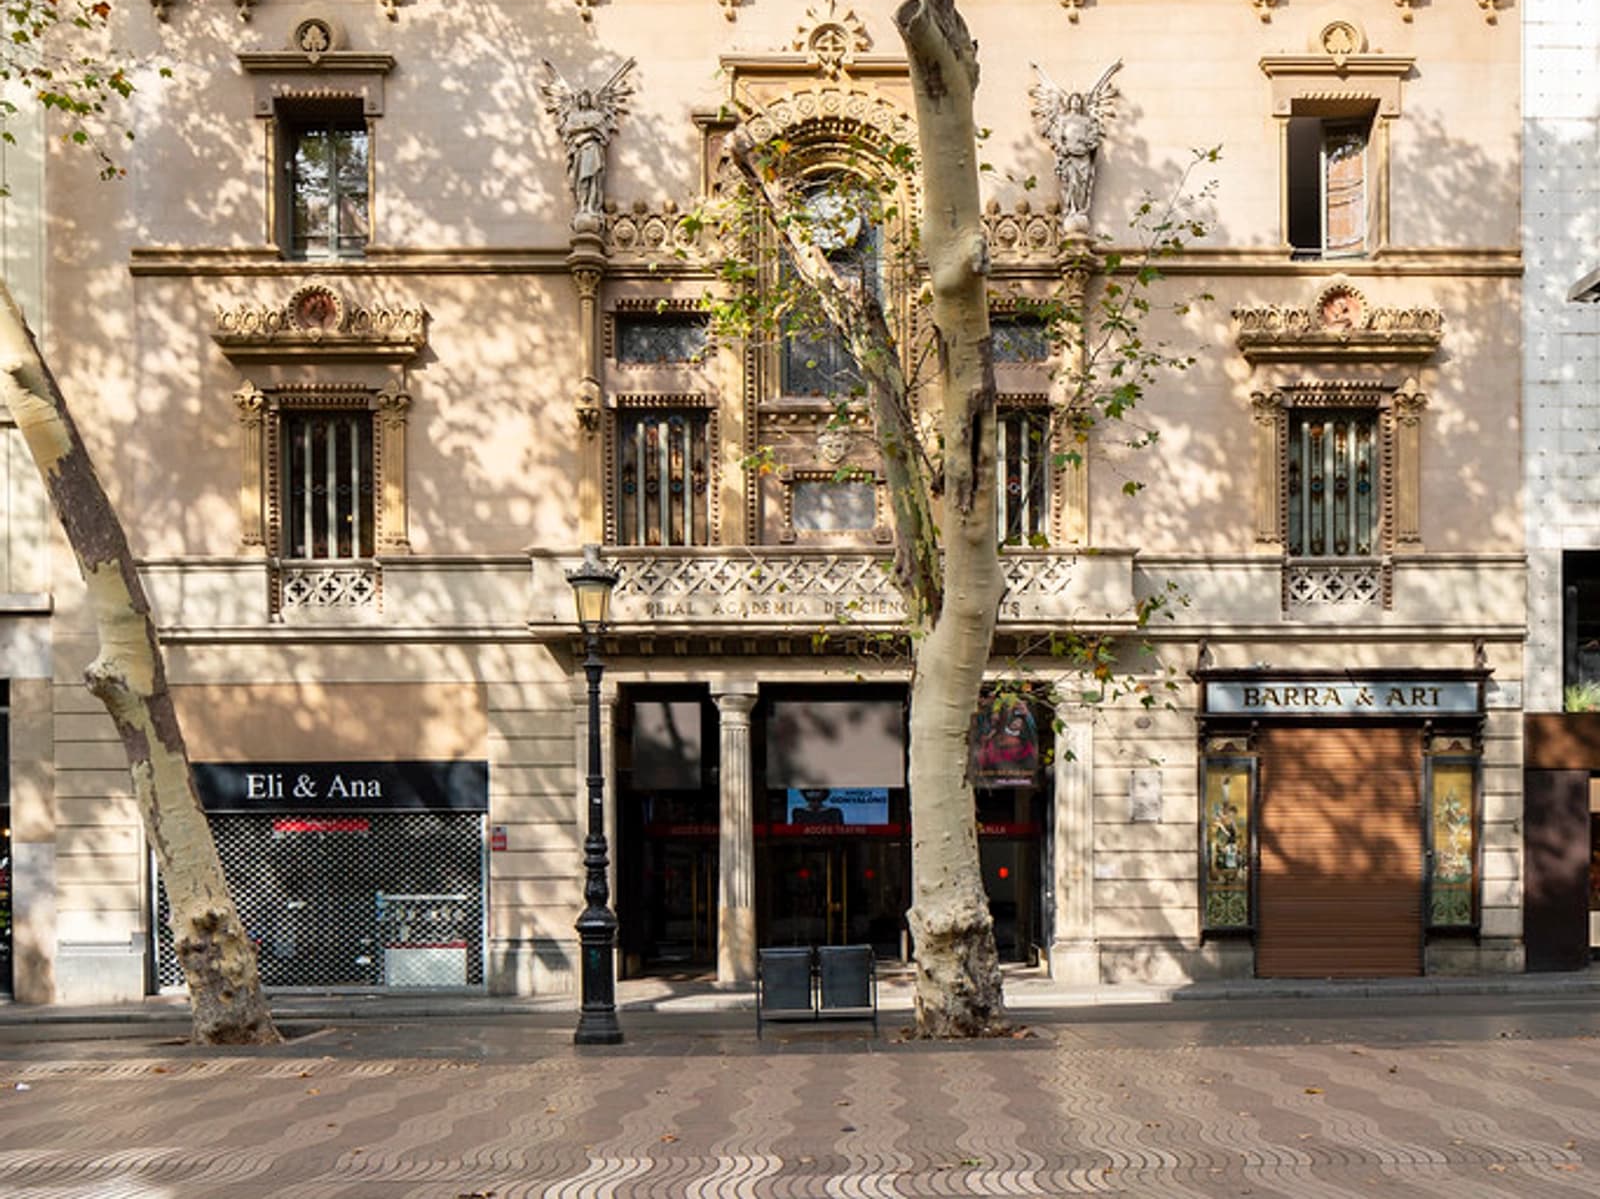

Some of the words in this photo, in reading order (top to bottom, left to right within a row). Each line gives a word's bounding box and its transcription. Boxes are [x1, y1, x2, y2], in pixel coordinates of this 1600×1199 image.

[824, 601, 844, 614] DE
[1242, 686, 1342, 706] BARRA
[1355, 686, 1375, 706] &
[1386, 686, 1444, 706] ART
[246, 773, 285, 798] Eli
[292, 773, 318, 798] &
[327, 773, 382, 798] Ana
